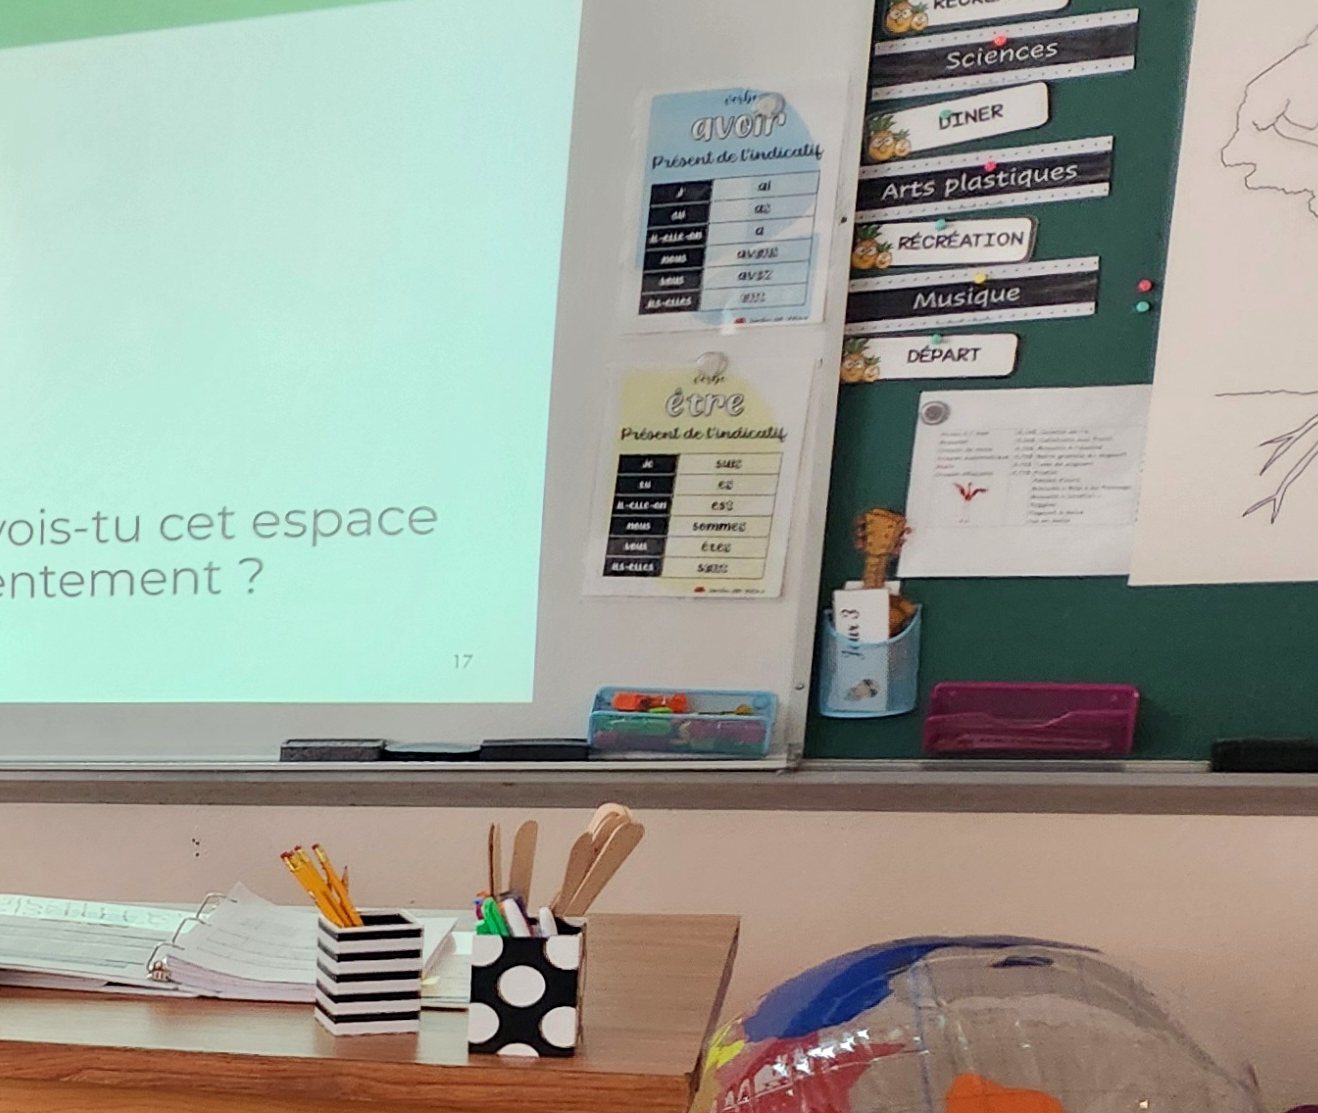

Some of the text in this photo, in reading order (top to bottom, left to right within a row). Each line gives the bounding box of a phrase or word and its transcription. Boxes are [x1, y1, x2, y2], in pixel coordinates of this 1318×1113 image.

[946, 41, 1059, 71] Sciences
[691, 110, 787, 143] avoir
[651, 150, 715, 170] Présent
[716, 149, 738, 164] de
[881, 163, 1079, 201] Arts plastiques
[897, 230, 1025, 250] RÉCRÉATION
[913, 286, 1021, 310] Musique
[907, 346, 981, 364] DÉPART
[666, 387, 745, 418] être
[620, 427, 681, 441] Présent
[683, 425, 704, 440] de
[158, 503, 236, 542] cet
[252, 503, 439, 547] espace
[238, 557, 265, 595] ?
[452, 653, 474, 670] 17
